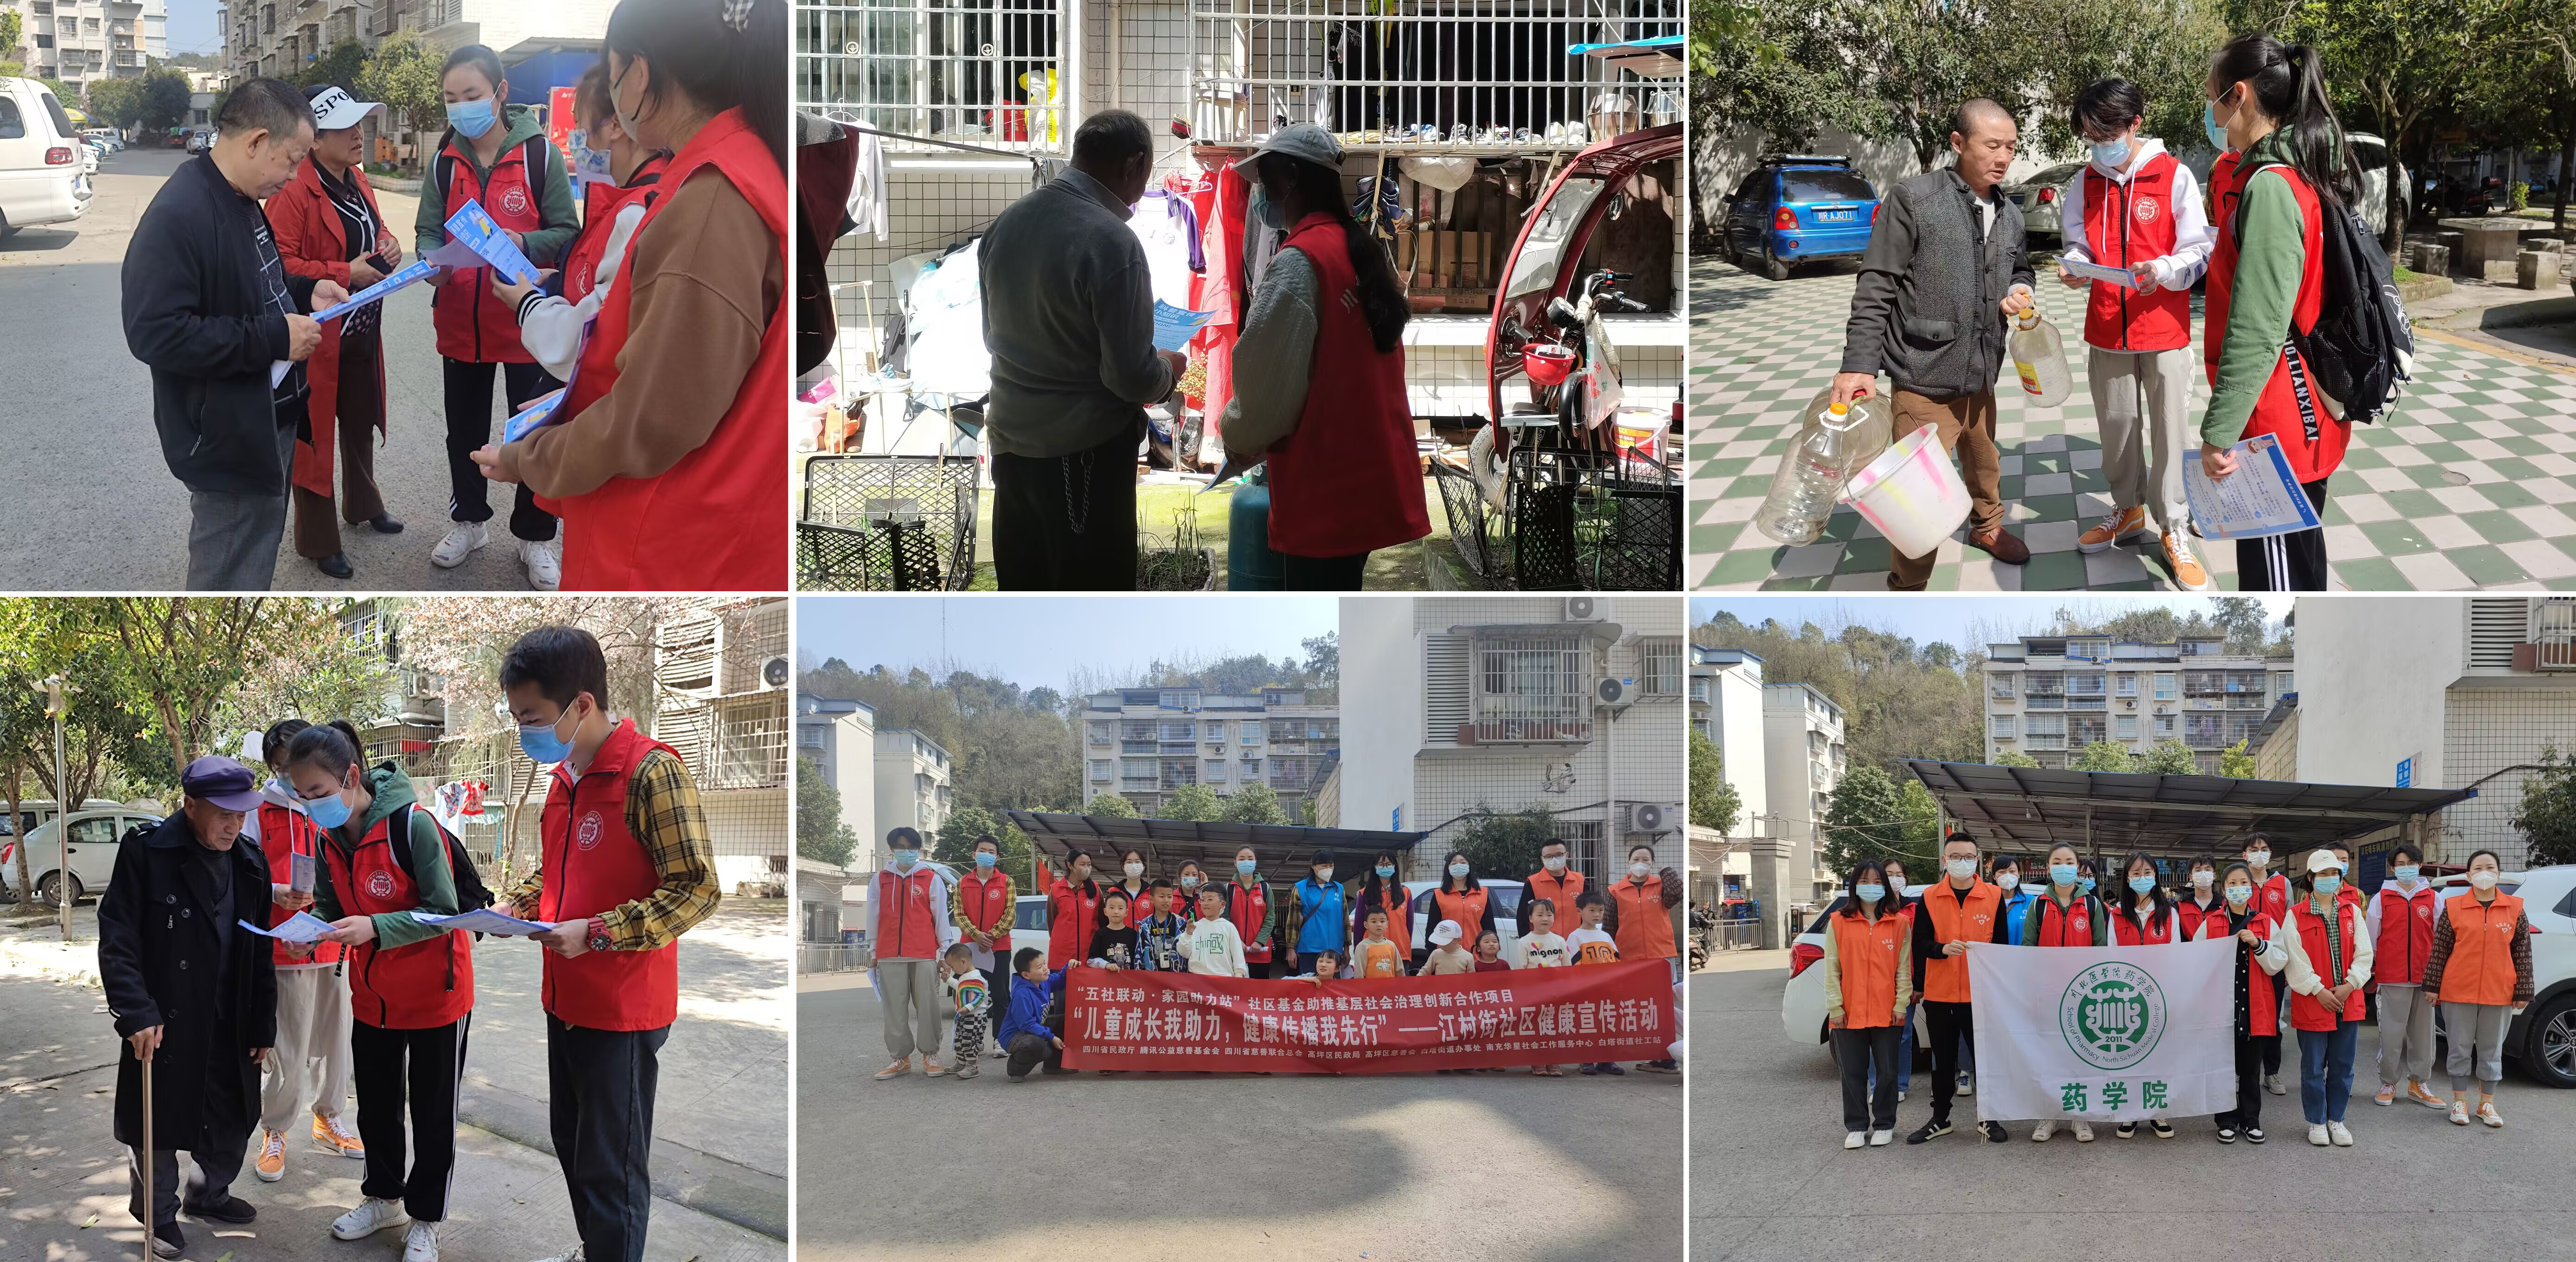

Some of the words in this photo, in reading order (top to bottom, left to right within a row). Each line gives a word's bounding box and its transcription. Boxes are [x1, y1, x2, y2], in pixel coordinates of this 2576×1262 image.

[314, 92, 349, 120] SPO
[1155, 309, 1179, 319] 小知识
[1159, 303, 1196, 317] 科普宣传
[2413, 759, 2417, 781] 1
[1531, 949, 1562, 958] mignon
[2071, 967, 2155, 998] 川北医学院药学院
[1248, 989, 1513, 1012] 社区基金助推基层社会治理创新合作项目
[2067, 1007, 2075, 1028] School
[2074, 1036, 2100, 1061] Pharmacy
[2120, 1048, 2142, 1062] Sichuan
[2141, 1028, 2157, 1049] Medical
[1140, 1046, 1220, 1055] 腾讯公益慈善基金会
[1225, 1048, 1303, 1057] 四川省慈善联合总会
[1308, 1050, 1360, 1059] 高坪区民政局
[1365, 1049, 1416, 1058] 高坪区慈善会
[1421, 1044, 1481, 1054] 白塔街道办事处
[1486, 1039, 1593, 1051] 南充华星社会工作服务中心
[1599, 1036, 1661, 1046] 白塔街道社工站
[2061, 1080, 2168, 1112] 药学院
